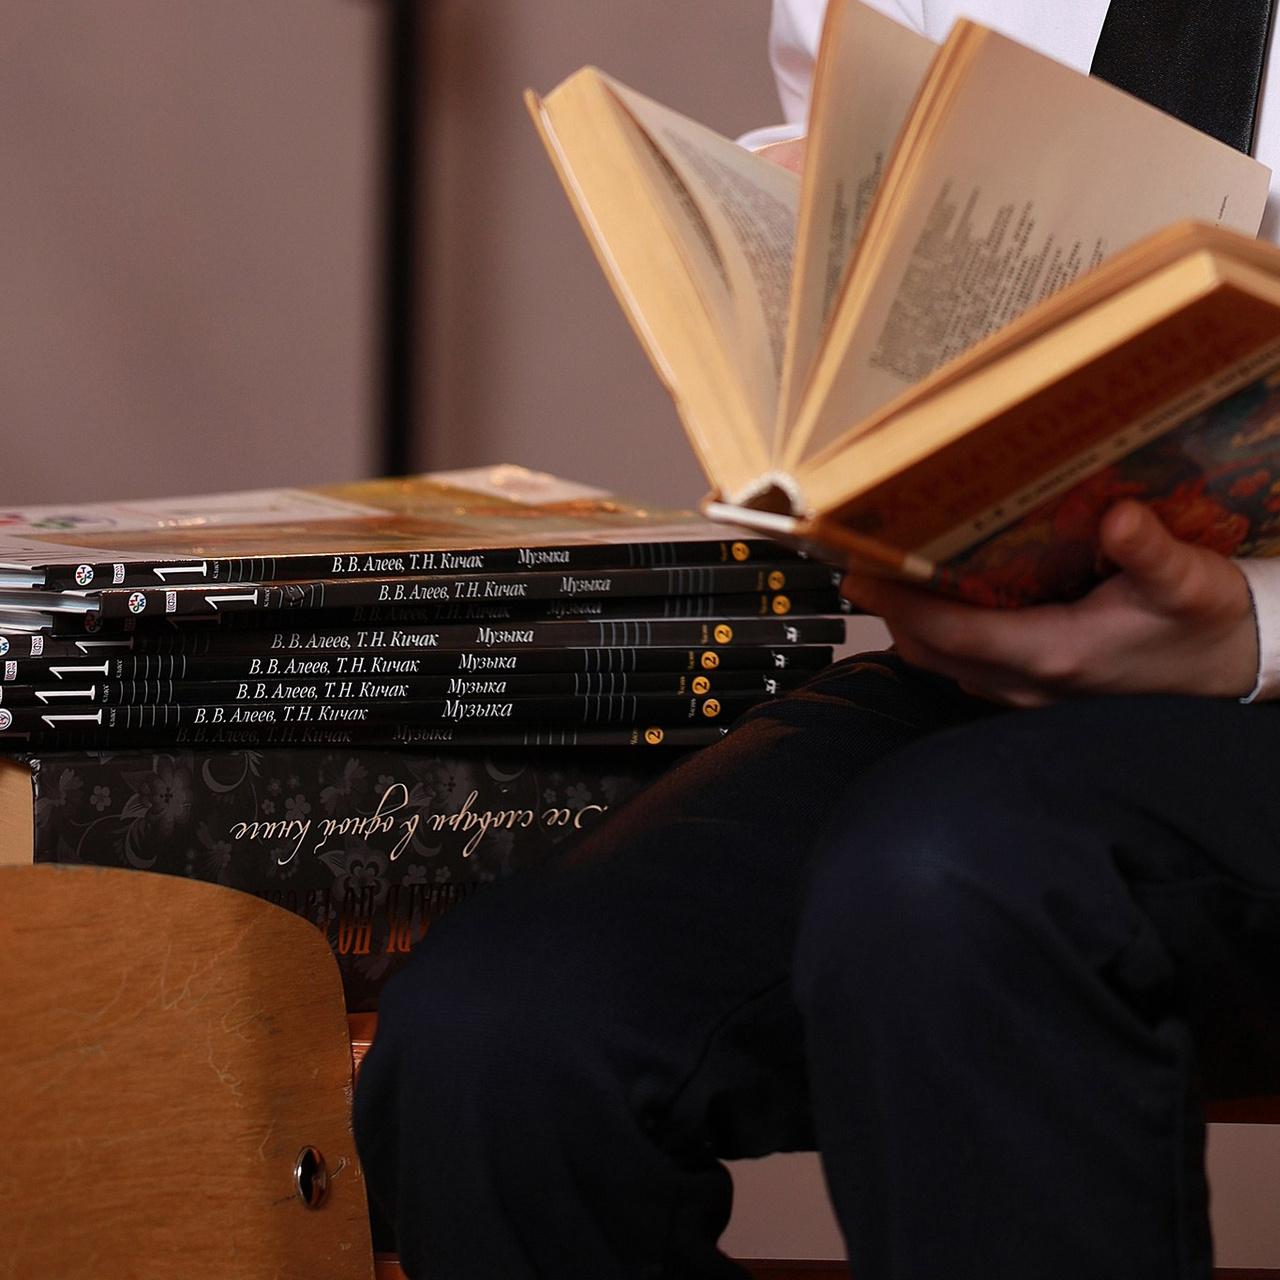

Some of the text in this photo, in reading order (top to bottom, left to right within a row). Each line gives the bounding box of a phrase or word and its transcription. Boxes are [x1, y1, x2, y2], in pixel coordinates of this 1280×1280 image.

[363, 555, 404, 573] Алеев,
[440, 552, 484, 569] Кичак
[517, 548, 570, 568] Музыка
[153, 561, 208, 582] 1
[560, 577, 612, 596] Музыка
[204, 589, 258, 610] 1
[75, 636, 133, 654] 1
[305, 633, 351, 650] Алеев,
[390, 630, 439, 647] Кичак
[476, 627, 534, 646] Музыка
[49, 660, 109, 680] 1
[284, 658, 330, 675] Алеев,
[371, 656, 420, 673] Кичак
[458, 653, 517, 673] Музыка
[34, 685, 95, 704] 1
[271, 683, 318, 700] Алеев,
[358, 681, 409, 698] Кичак
[447, 678, 507, 697] Музыка
[41, 708, 102, 729] 1
[229, 708, 277, 724] Алеев,
[317, 705, 368, 721] Кичак
[441, 699, 513, 722] Музыка
[392, 725, 453, 744] Музыка
[312, 783, 409, 854] одной
[426, 791, 534, 858] словари
[229, 817, 312, 866] книге
[389, 812, 420, 862] в
